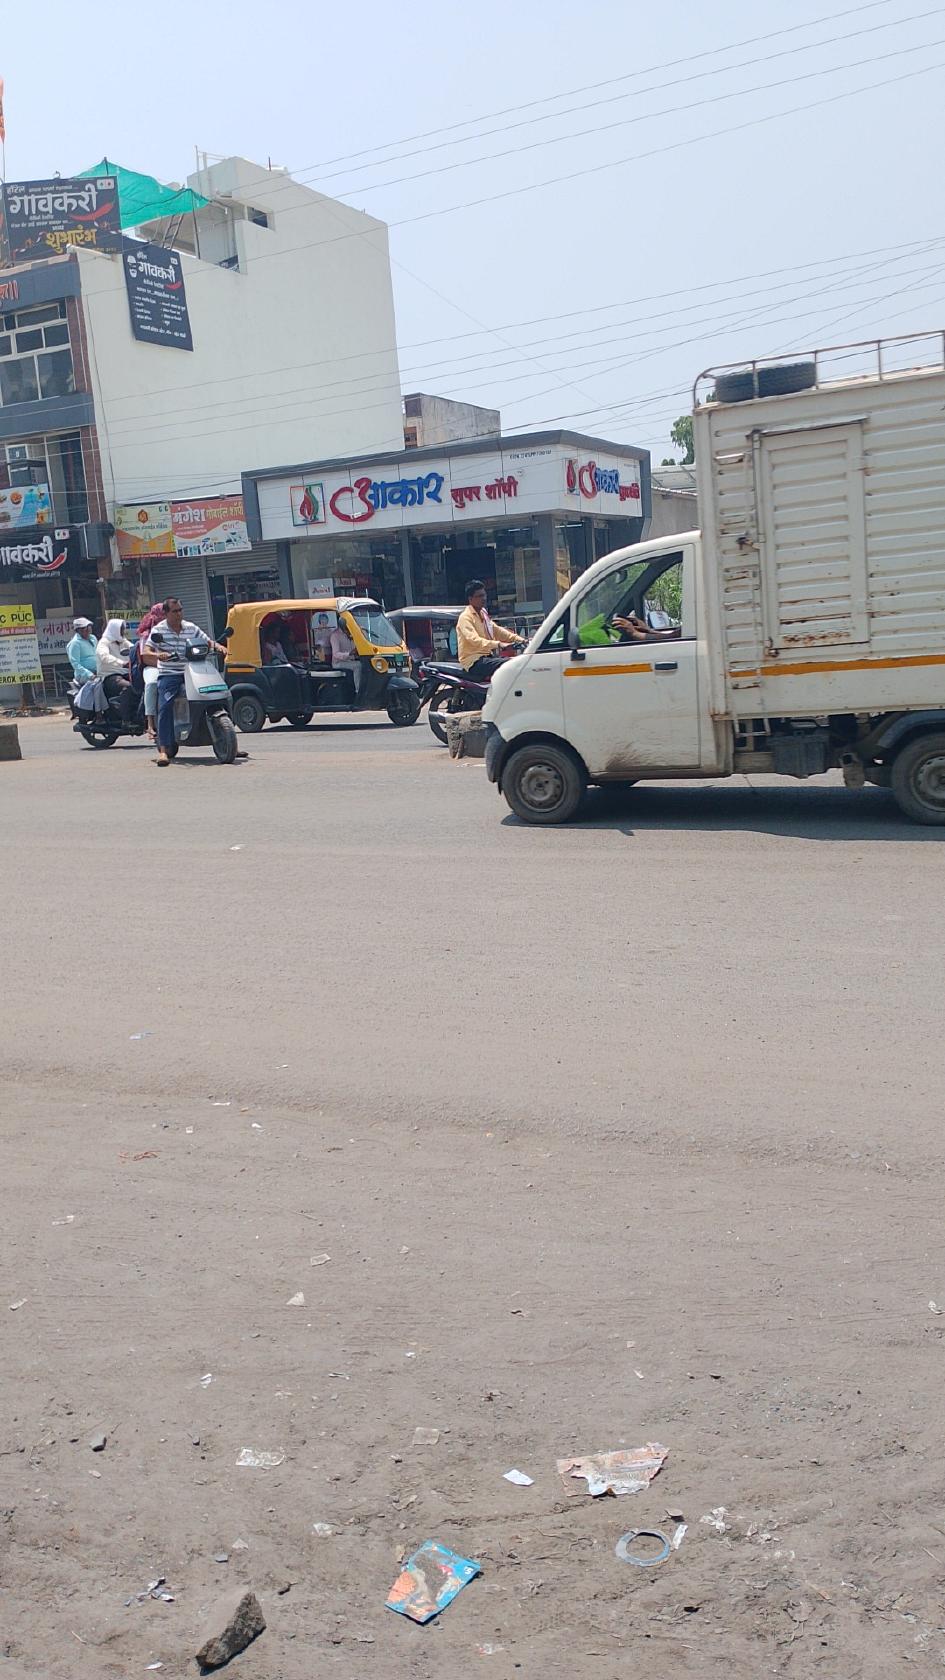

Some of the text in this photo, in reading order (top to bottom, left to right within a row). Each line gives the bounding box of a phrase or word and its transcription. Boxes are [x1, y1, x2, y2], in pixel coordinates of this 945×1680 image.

[8, 183, 98, 215] गावकरी
[46, 224, 97, 254] शुभारंभ
[137, 261, 176, 284] गावकरी
[330, 472, 519, 522] आकार सुपर शॉपी
[172, 504, 206, 523] मंगेश
[11, 612, 32, 622] PUC
